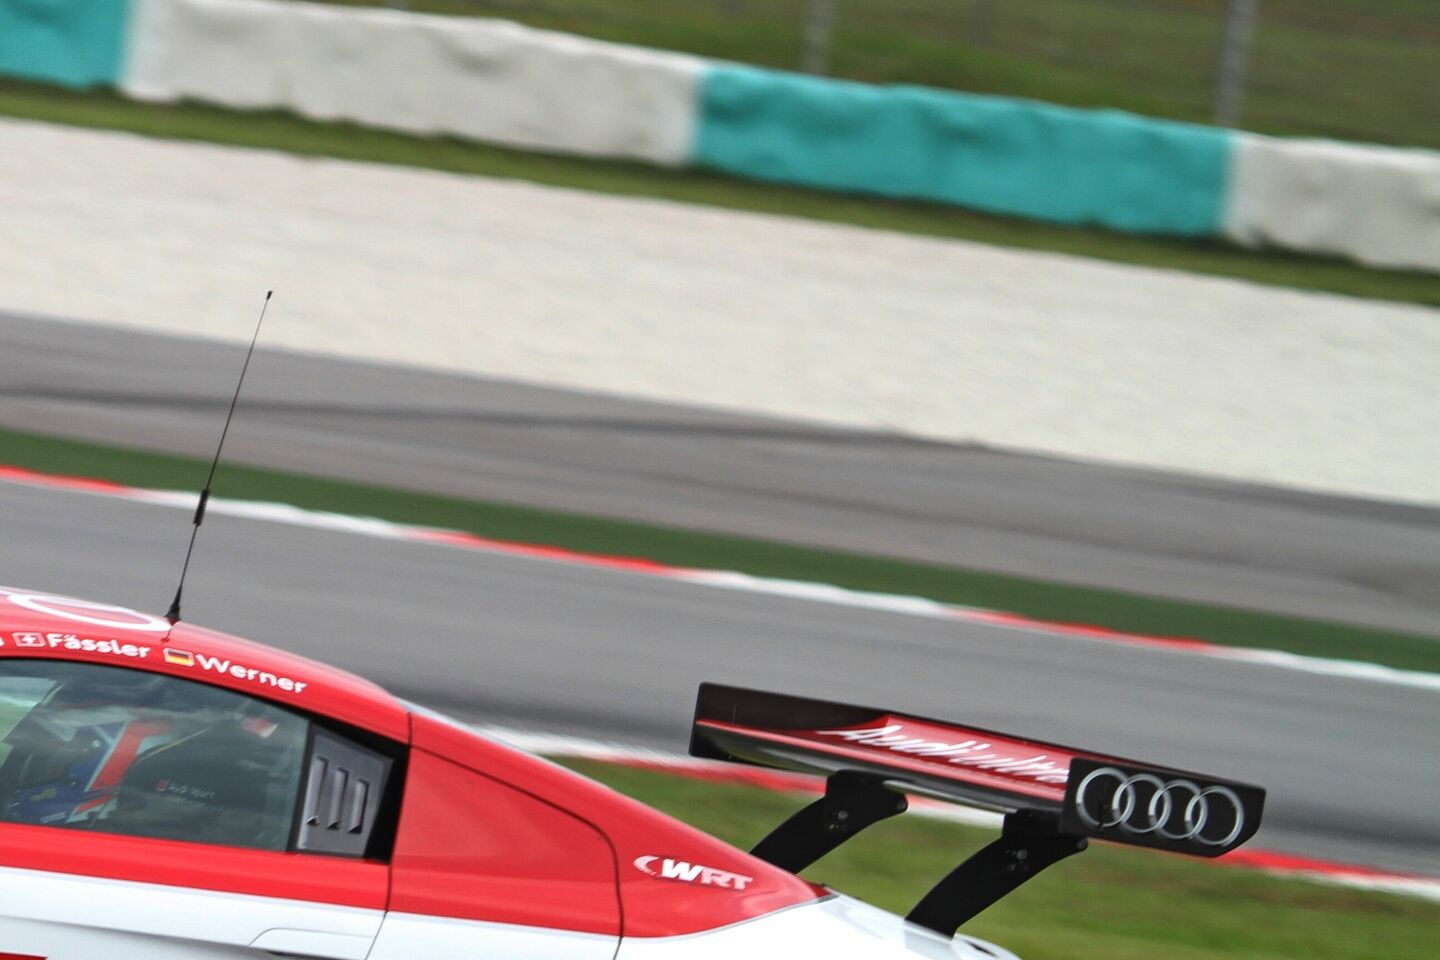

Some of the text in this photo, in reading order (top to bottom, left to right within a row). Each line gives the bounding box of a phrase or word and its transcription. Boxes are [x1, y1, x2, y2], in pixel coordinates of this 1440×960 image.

[45, 633, 151, 659] Fässler
[195, 652, 308, 695] Werner
[662, 858, 753, 891] WRT
